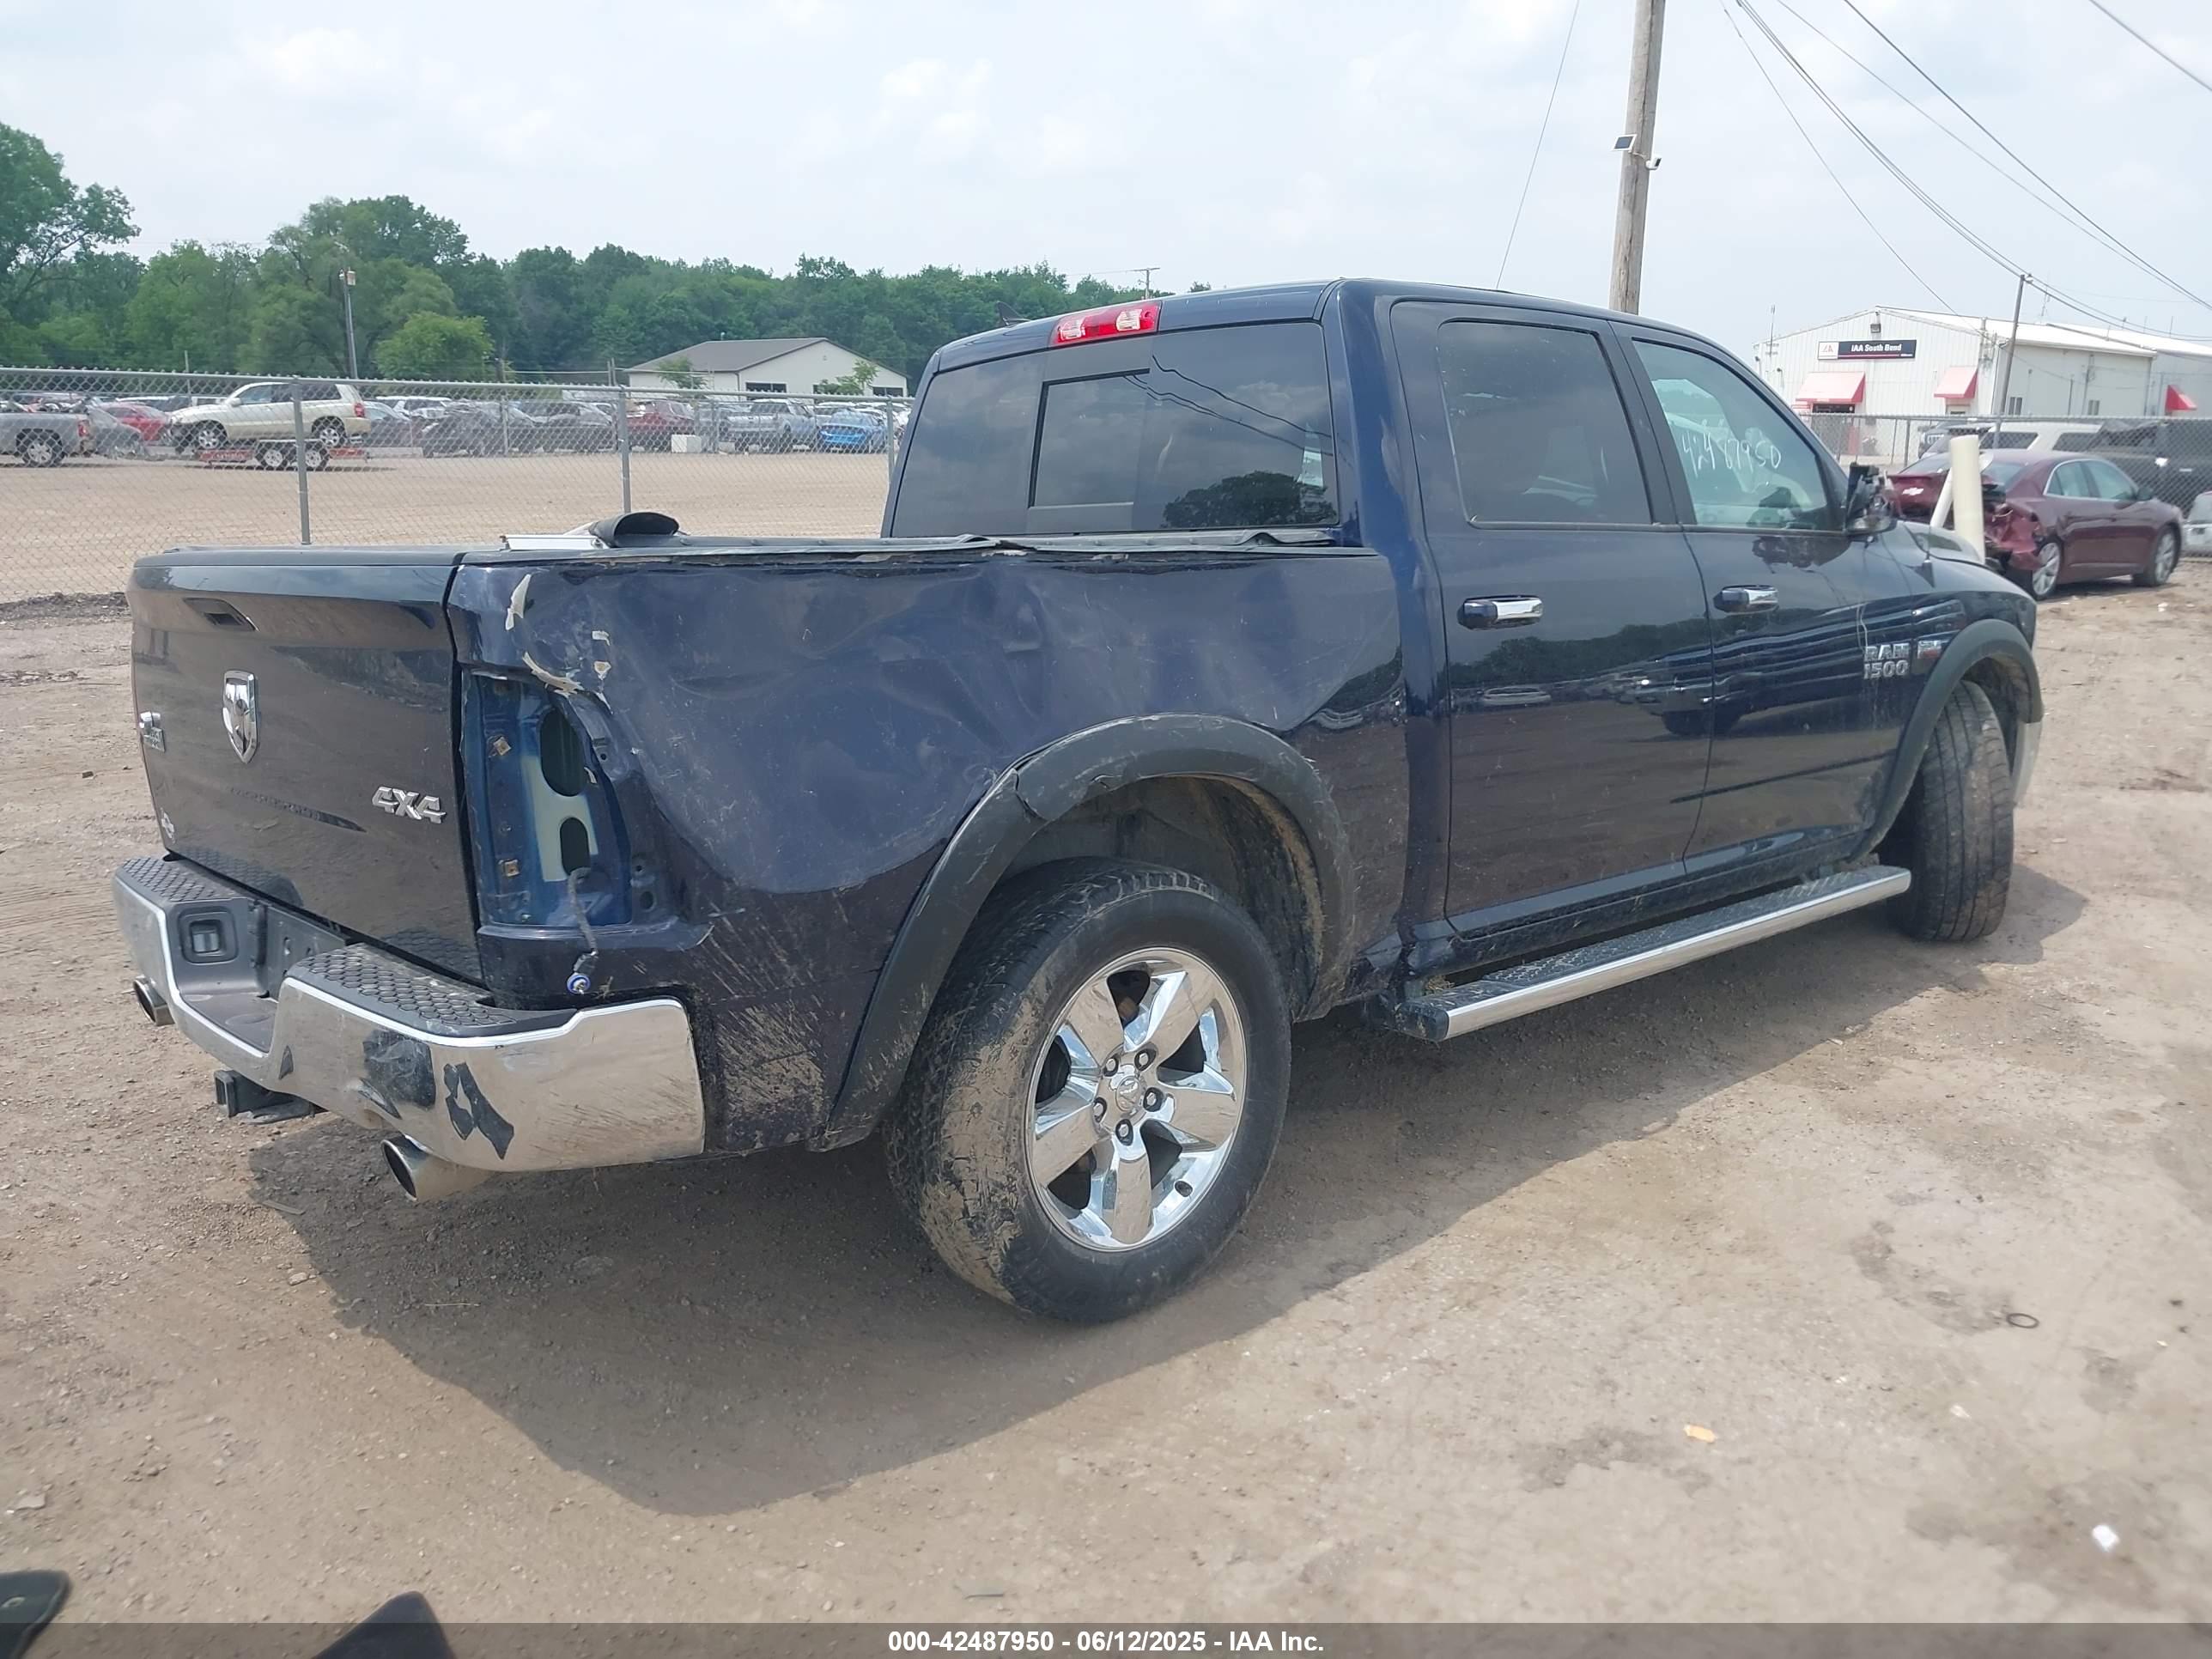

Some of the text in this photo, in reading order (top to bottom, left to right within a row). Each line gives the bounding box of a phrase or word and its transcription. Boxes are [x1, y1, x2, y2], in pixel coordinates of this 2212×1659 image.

[1850, 343, 1902, 352] IAA South Bend
[1864, 643, 1910, 661] RAM
[1863, 659, 1909, 679] 1500
